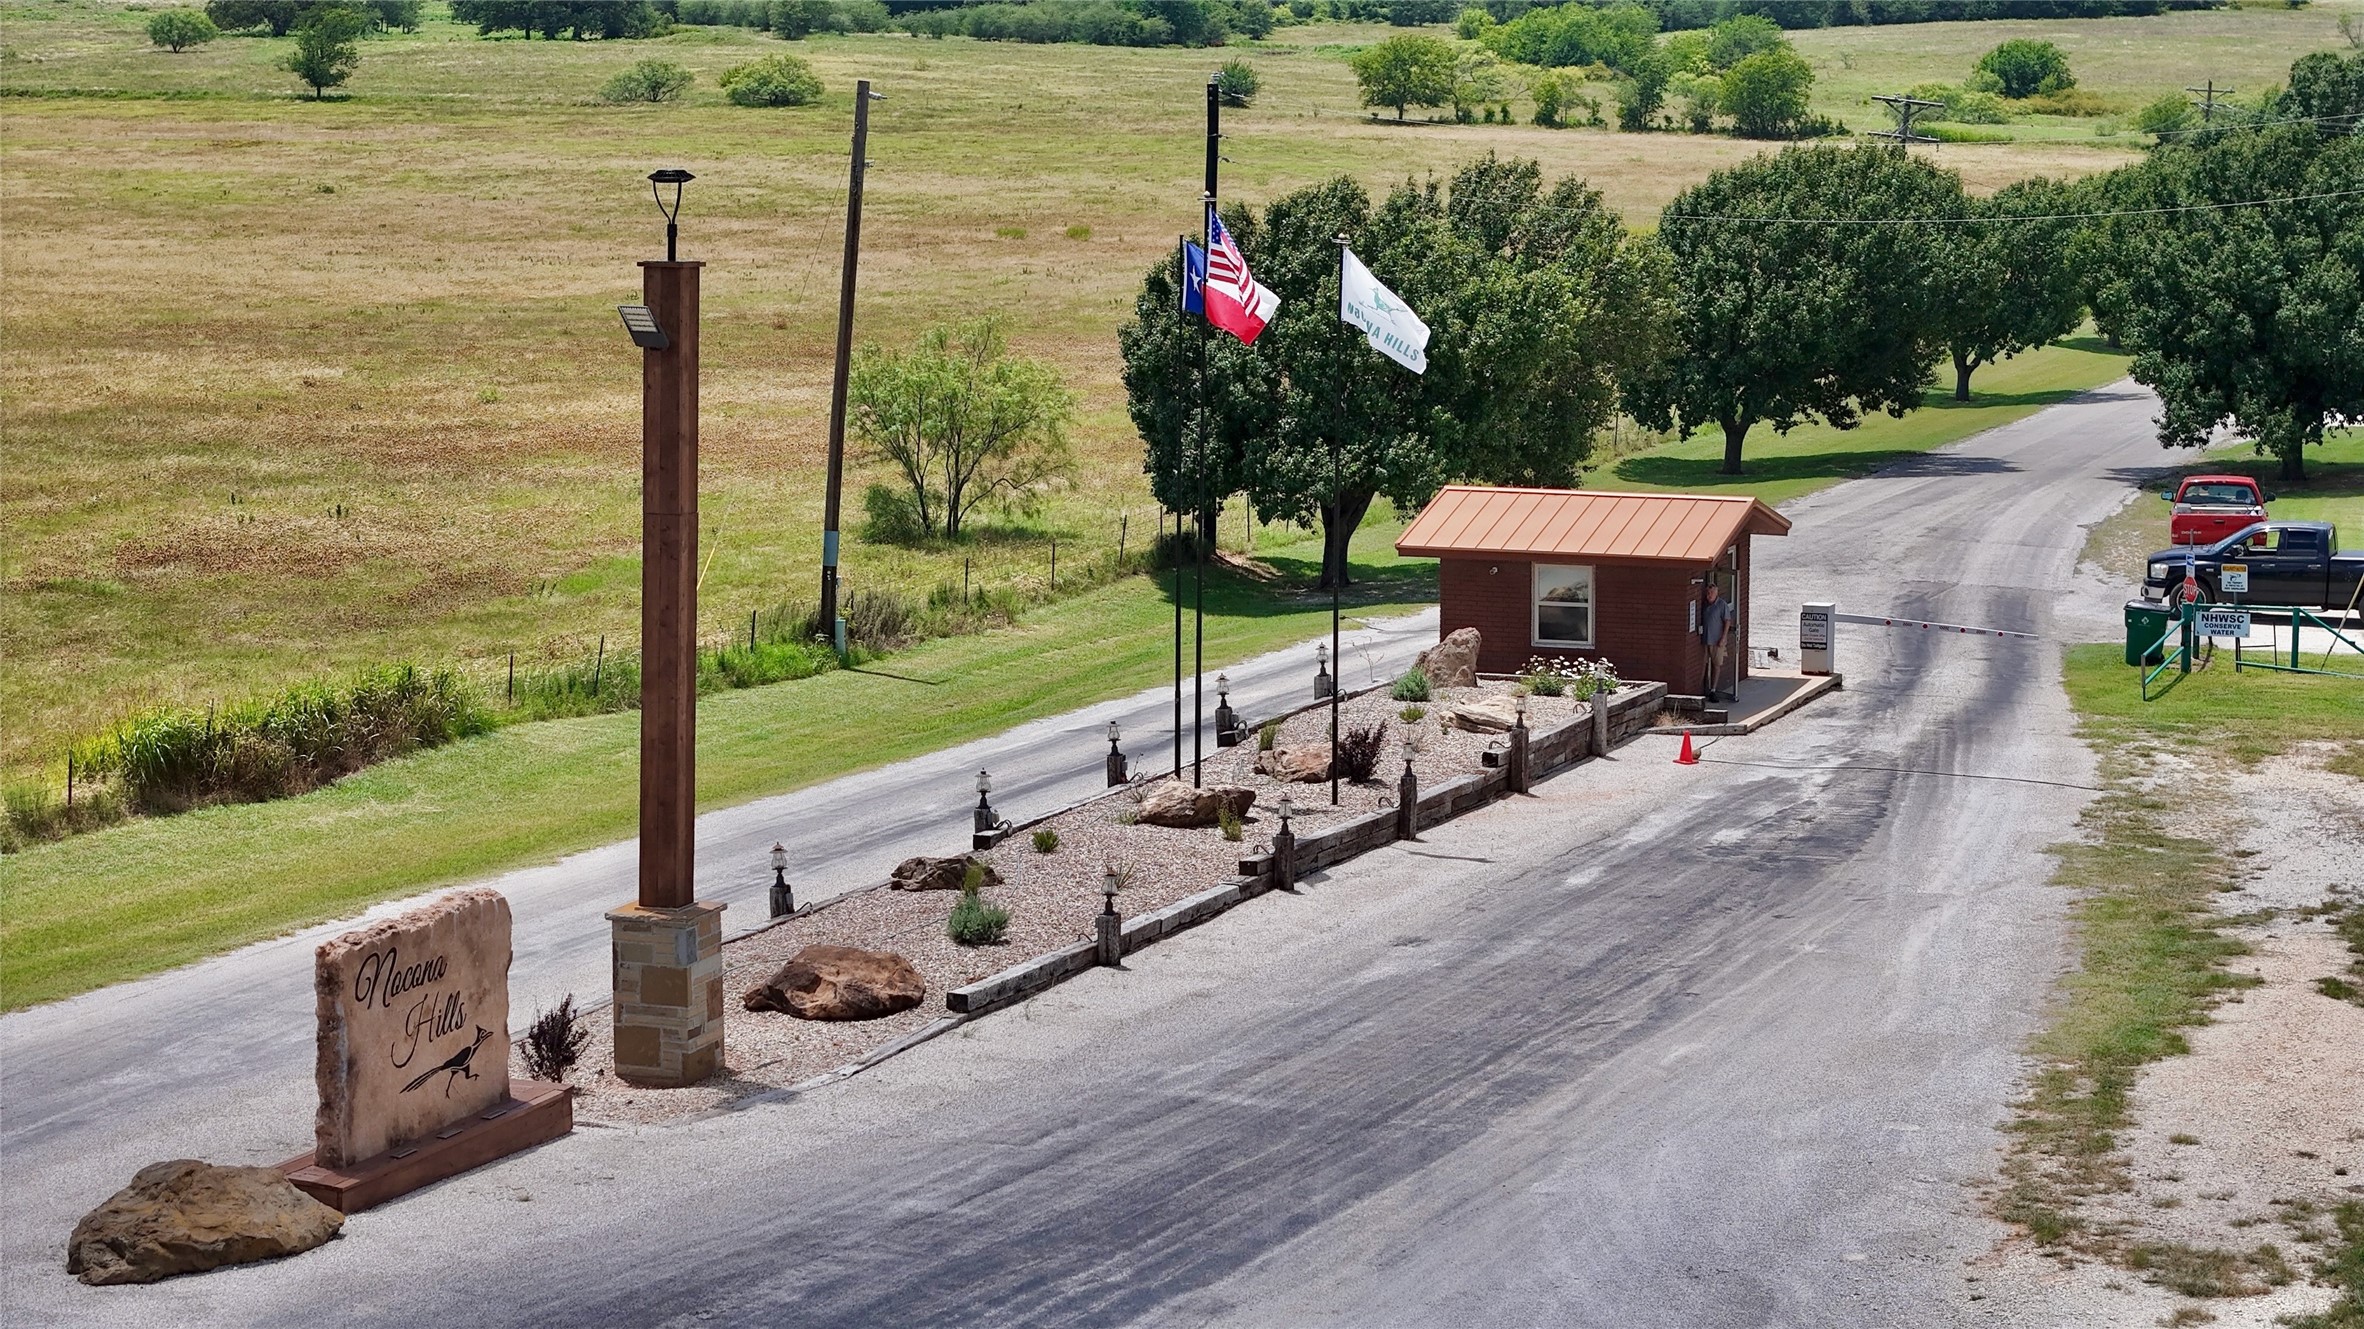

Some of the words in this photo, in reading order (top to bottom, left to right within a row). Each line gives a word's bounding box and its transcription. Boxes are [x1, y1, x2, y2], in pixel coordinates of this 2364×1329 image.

[1384, 332, 1420, 361] HILLS
[2184, 584, 2197, 595] STOP
[2201, 613, 2245, 624] NHWSC
[354, 947, 449, 1010] Nocona
[391, 989, 468, 1068] Hills
